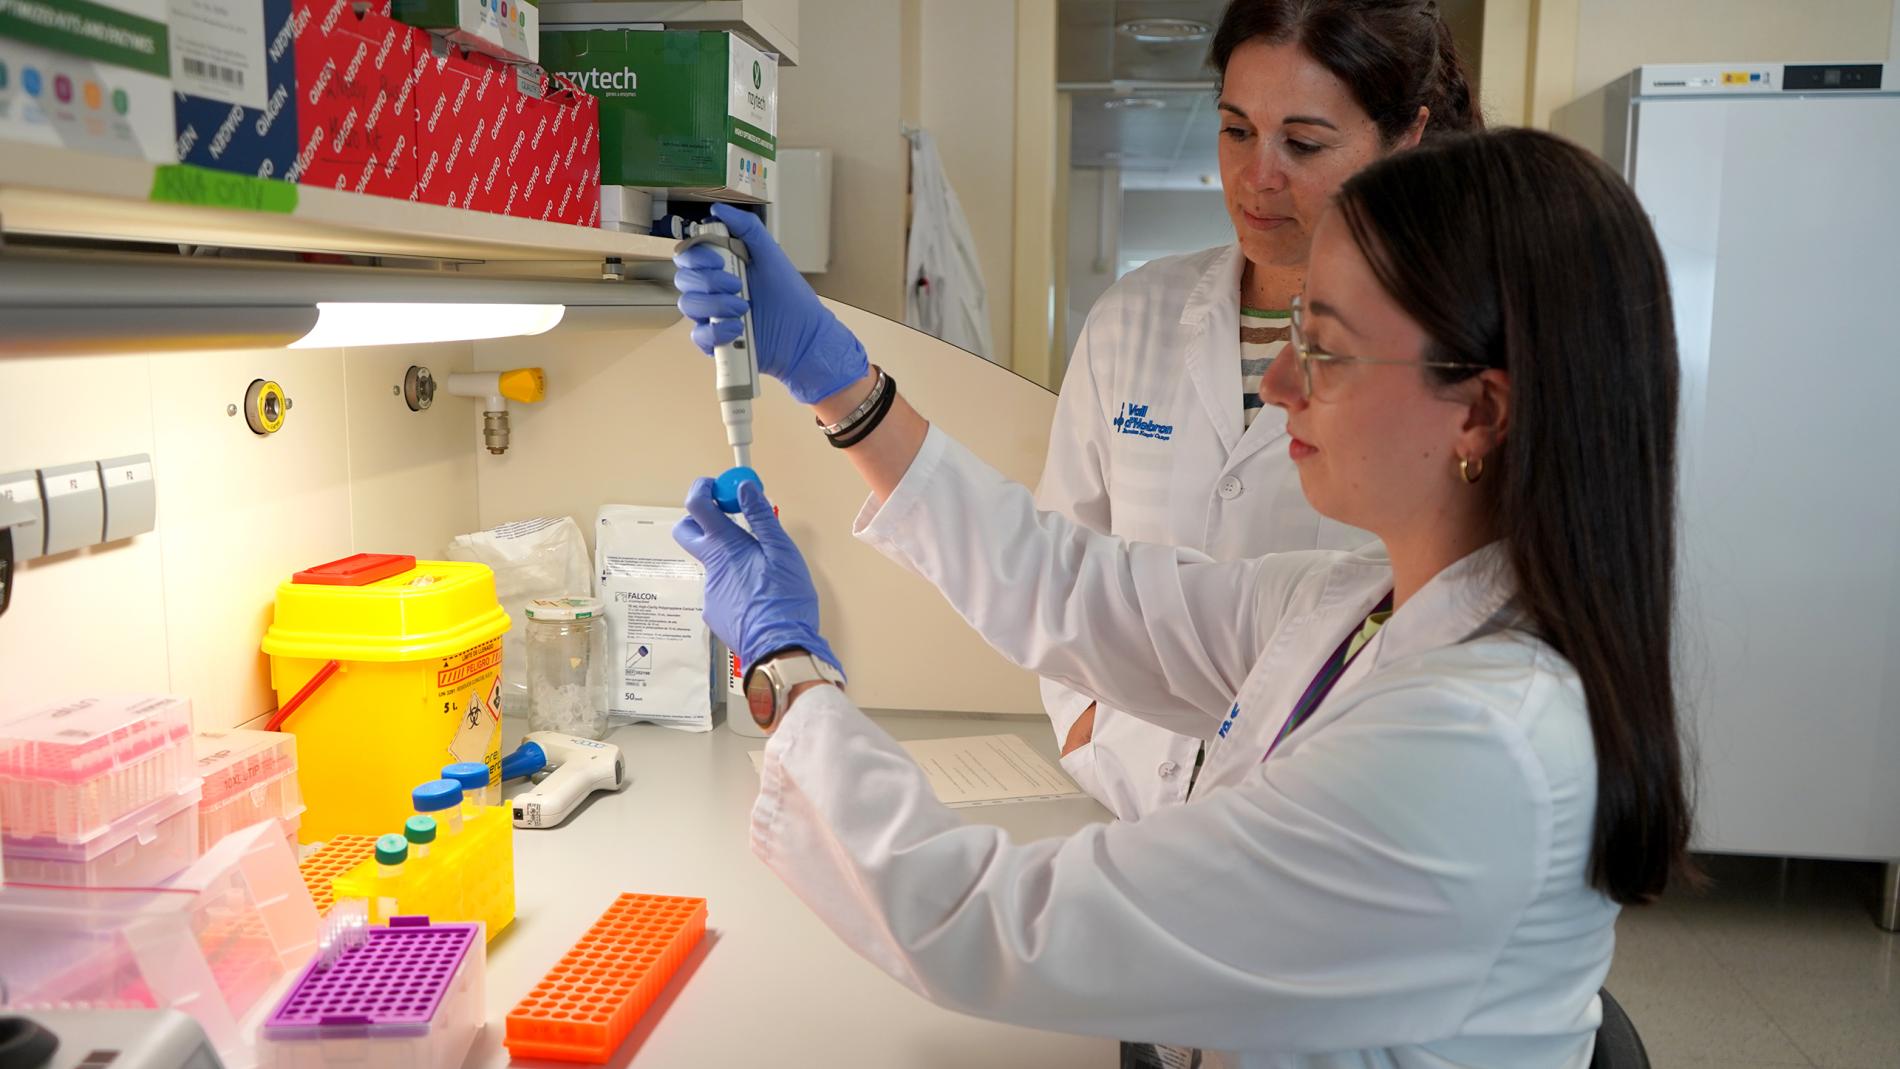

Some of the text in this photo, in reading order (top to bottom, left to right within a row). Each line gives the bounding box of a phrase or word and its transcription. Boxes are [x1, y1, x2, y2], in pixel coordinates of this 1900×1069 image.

[344, 41, 367, 87] QIAGEN
[375, 27, 396, 70] QIAGEN
[309, 56, 336, 105] QIAGEN
[394, 73, 414, 116] QIAGEN
[452, 78, 471, 117] QIAGEN
[476, 64, 494, 102] QIAGEN
[255, 83, 288, 136] QIAGEN
[365, 89, 387, 133] QIAGEN
[427, 92, 447, 133] QIAGEN
[490, 103, 508, 141] QIAGEN
[208, 105, 245, 160] QIAGEN
[333, 106, 359, 154] QIAGEN
[468, 118, 485, 157] QIAGEN
[509, 130, 526, 167] QIAGEN
[531, 115, 548, 150] QIAGEN
[582, 123, 594, 155] QIAGEN
[384, 135, 406, 179] QIAGEN
[418, 150, 439, 193] QIAGEN
[445, 133, 464, 174] QIAGEN
[545, 150, 561, 185] QIAGEN
[565, 136, 578, 170] QIAGEN
[484, 156, 501, 195] QIAGEN
[523, 166, 540, 202] QIAGEN
[575, 169, 589, 202] QIAGEN
[557, 184, 573, 217] QIAGEN
[1128, 402, 1149, 418] Vall
[627, 592, 657, 601] FALCON
[466, 656, 490, 674] PELIGRO
[443, 701, 450, 714] 5
[625, 692, 635, 701] 50
